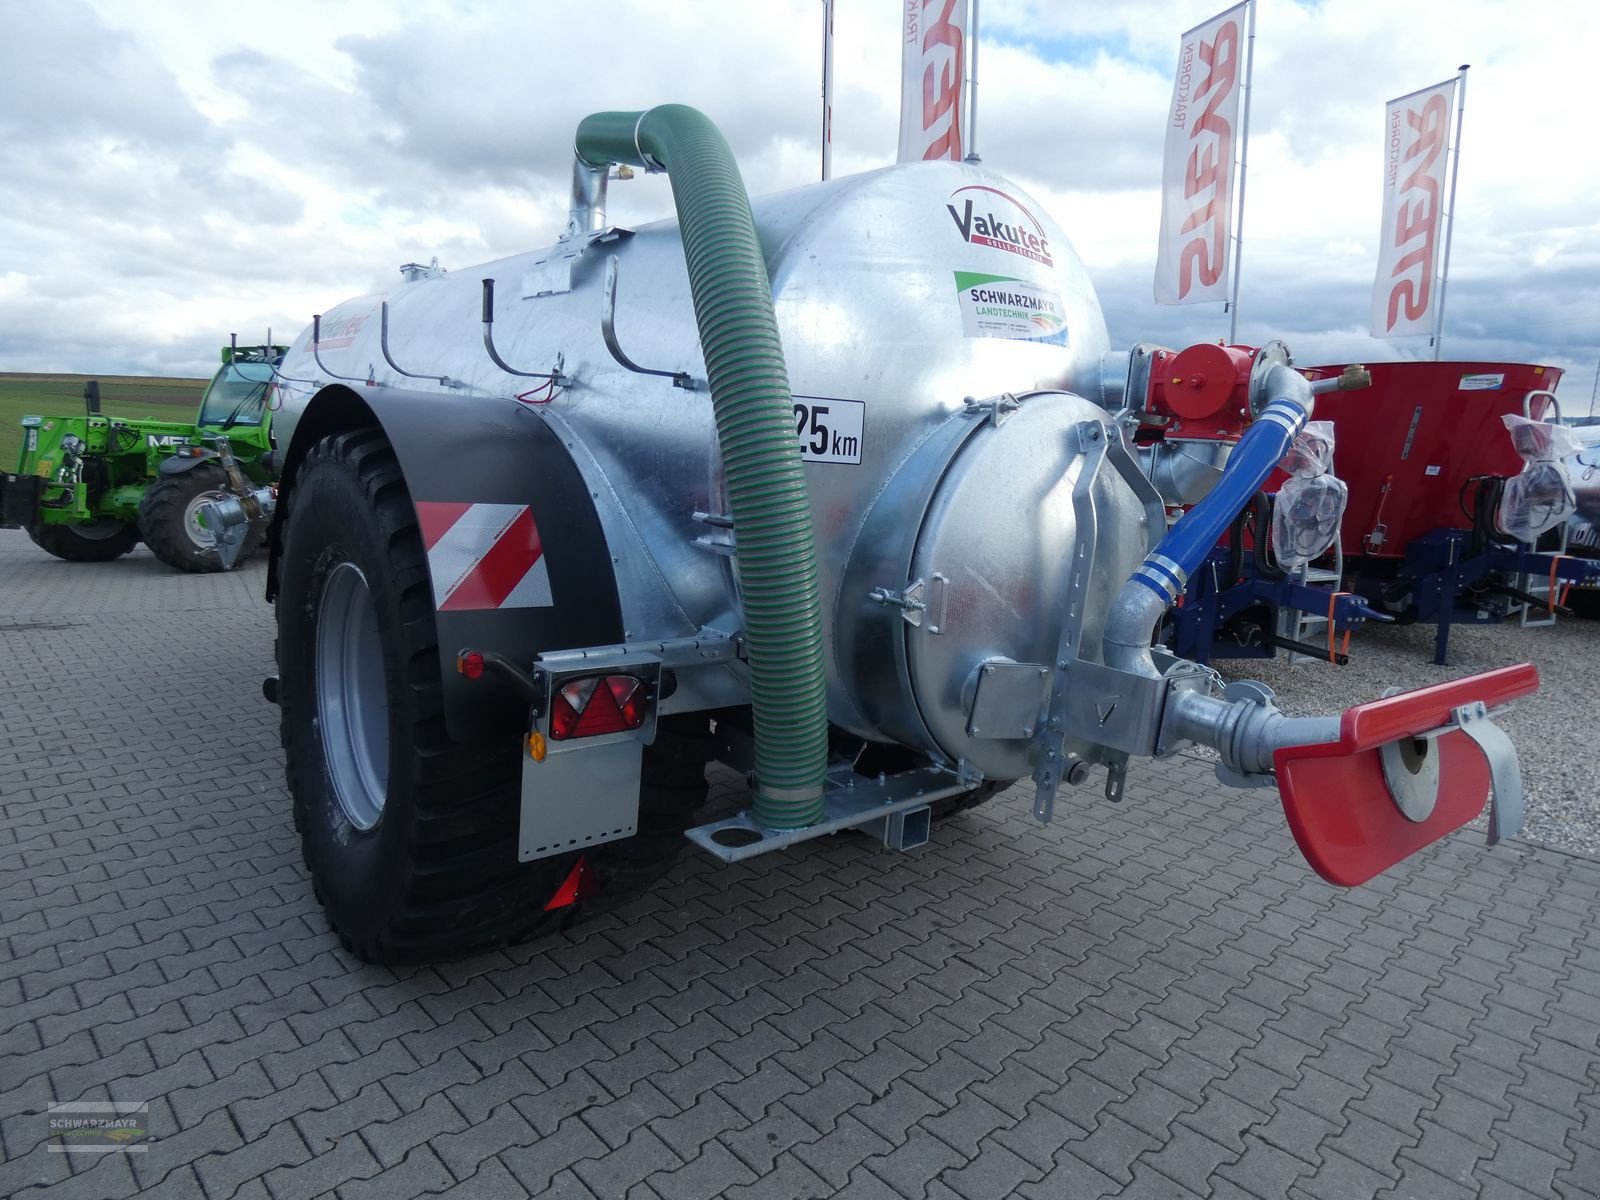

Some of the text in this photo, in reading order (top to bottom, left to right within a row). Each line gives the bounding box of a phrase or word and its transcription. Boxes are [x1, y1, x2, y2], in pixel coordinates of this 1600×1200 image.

[945, 198, 1052, 258] Vakutec
[970, 288, 1056, 313] SCHWARZMAYR
[975, 306, 1030, 320] LANDTECHNIK
[831, 429, 858, 457] km
